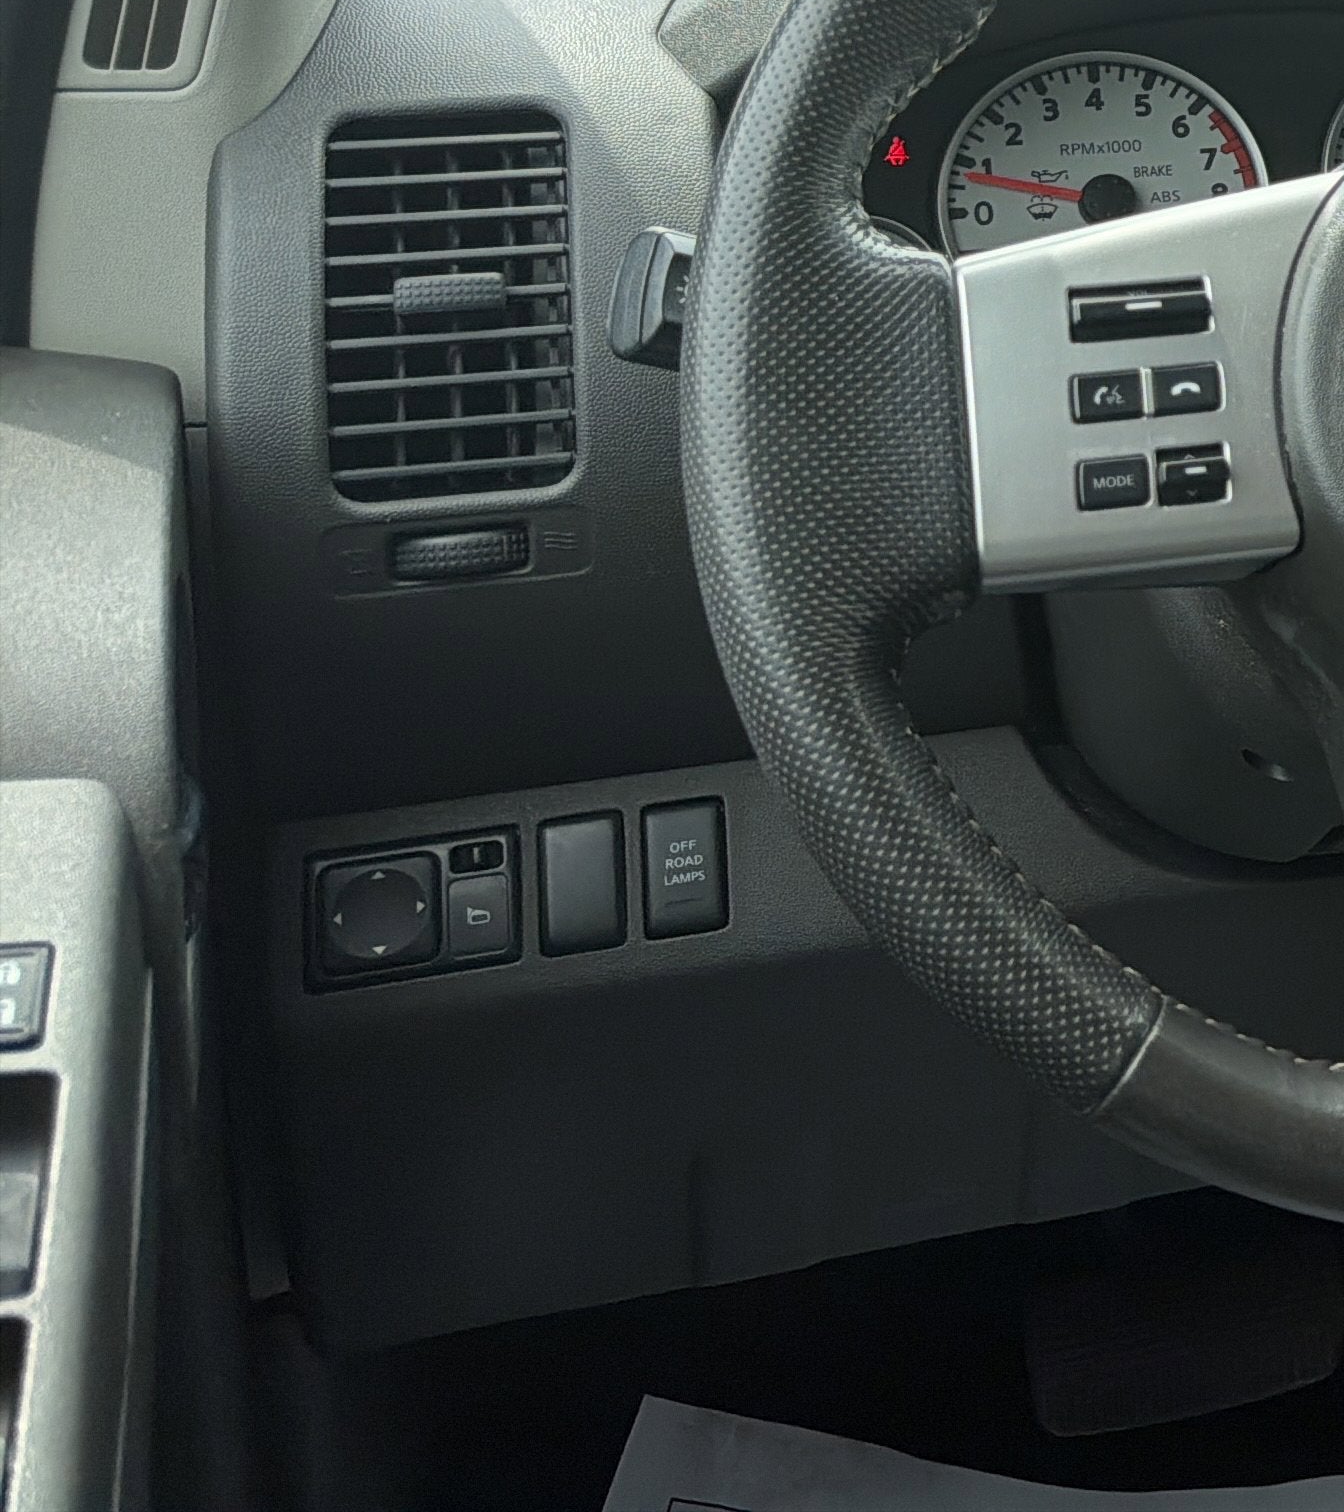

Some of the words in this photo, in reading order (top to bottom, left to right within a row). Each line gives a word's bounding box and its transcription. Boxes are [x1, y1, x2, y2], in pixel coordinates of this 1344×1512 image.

[1084, 88, 1104, 111] 4
[1134, 93, 1152, 116] 5
[1042, 98, 1060, 121] 3
[1171, 115, 1190, 138] 6
[1004, 125, 1023, 146] 2
[1059, 139, 1142, 156] RPMx1000
[981, 158, 993, 175] 1
[1199, 147, 1217, 171] 7
[1133, 164, 1173, 179] BRAKE
[1150, 189, 1181, 204] ABS
[974, 201, 994, 225] 0
[1093, 473, 1135, 490] MODE
[669, 839, 697, 854] OFF
[665, 853, 704, 870] ROAD
[663, 870, 706, 887] LAMPS
